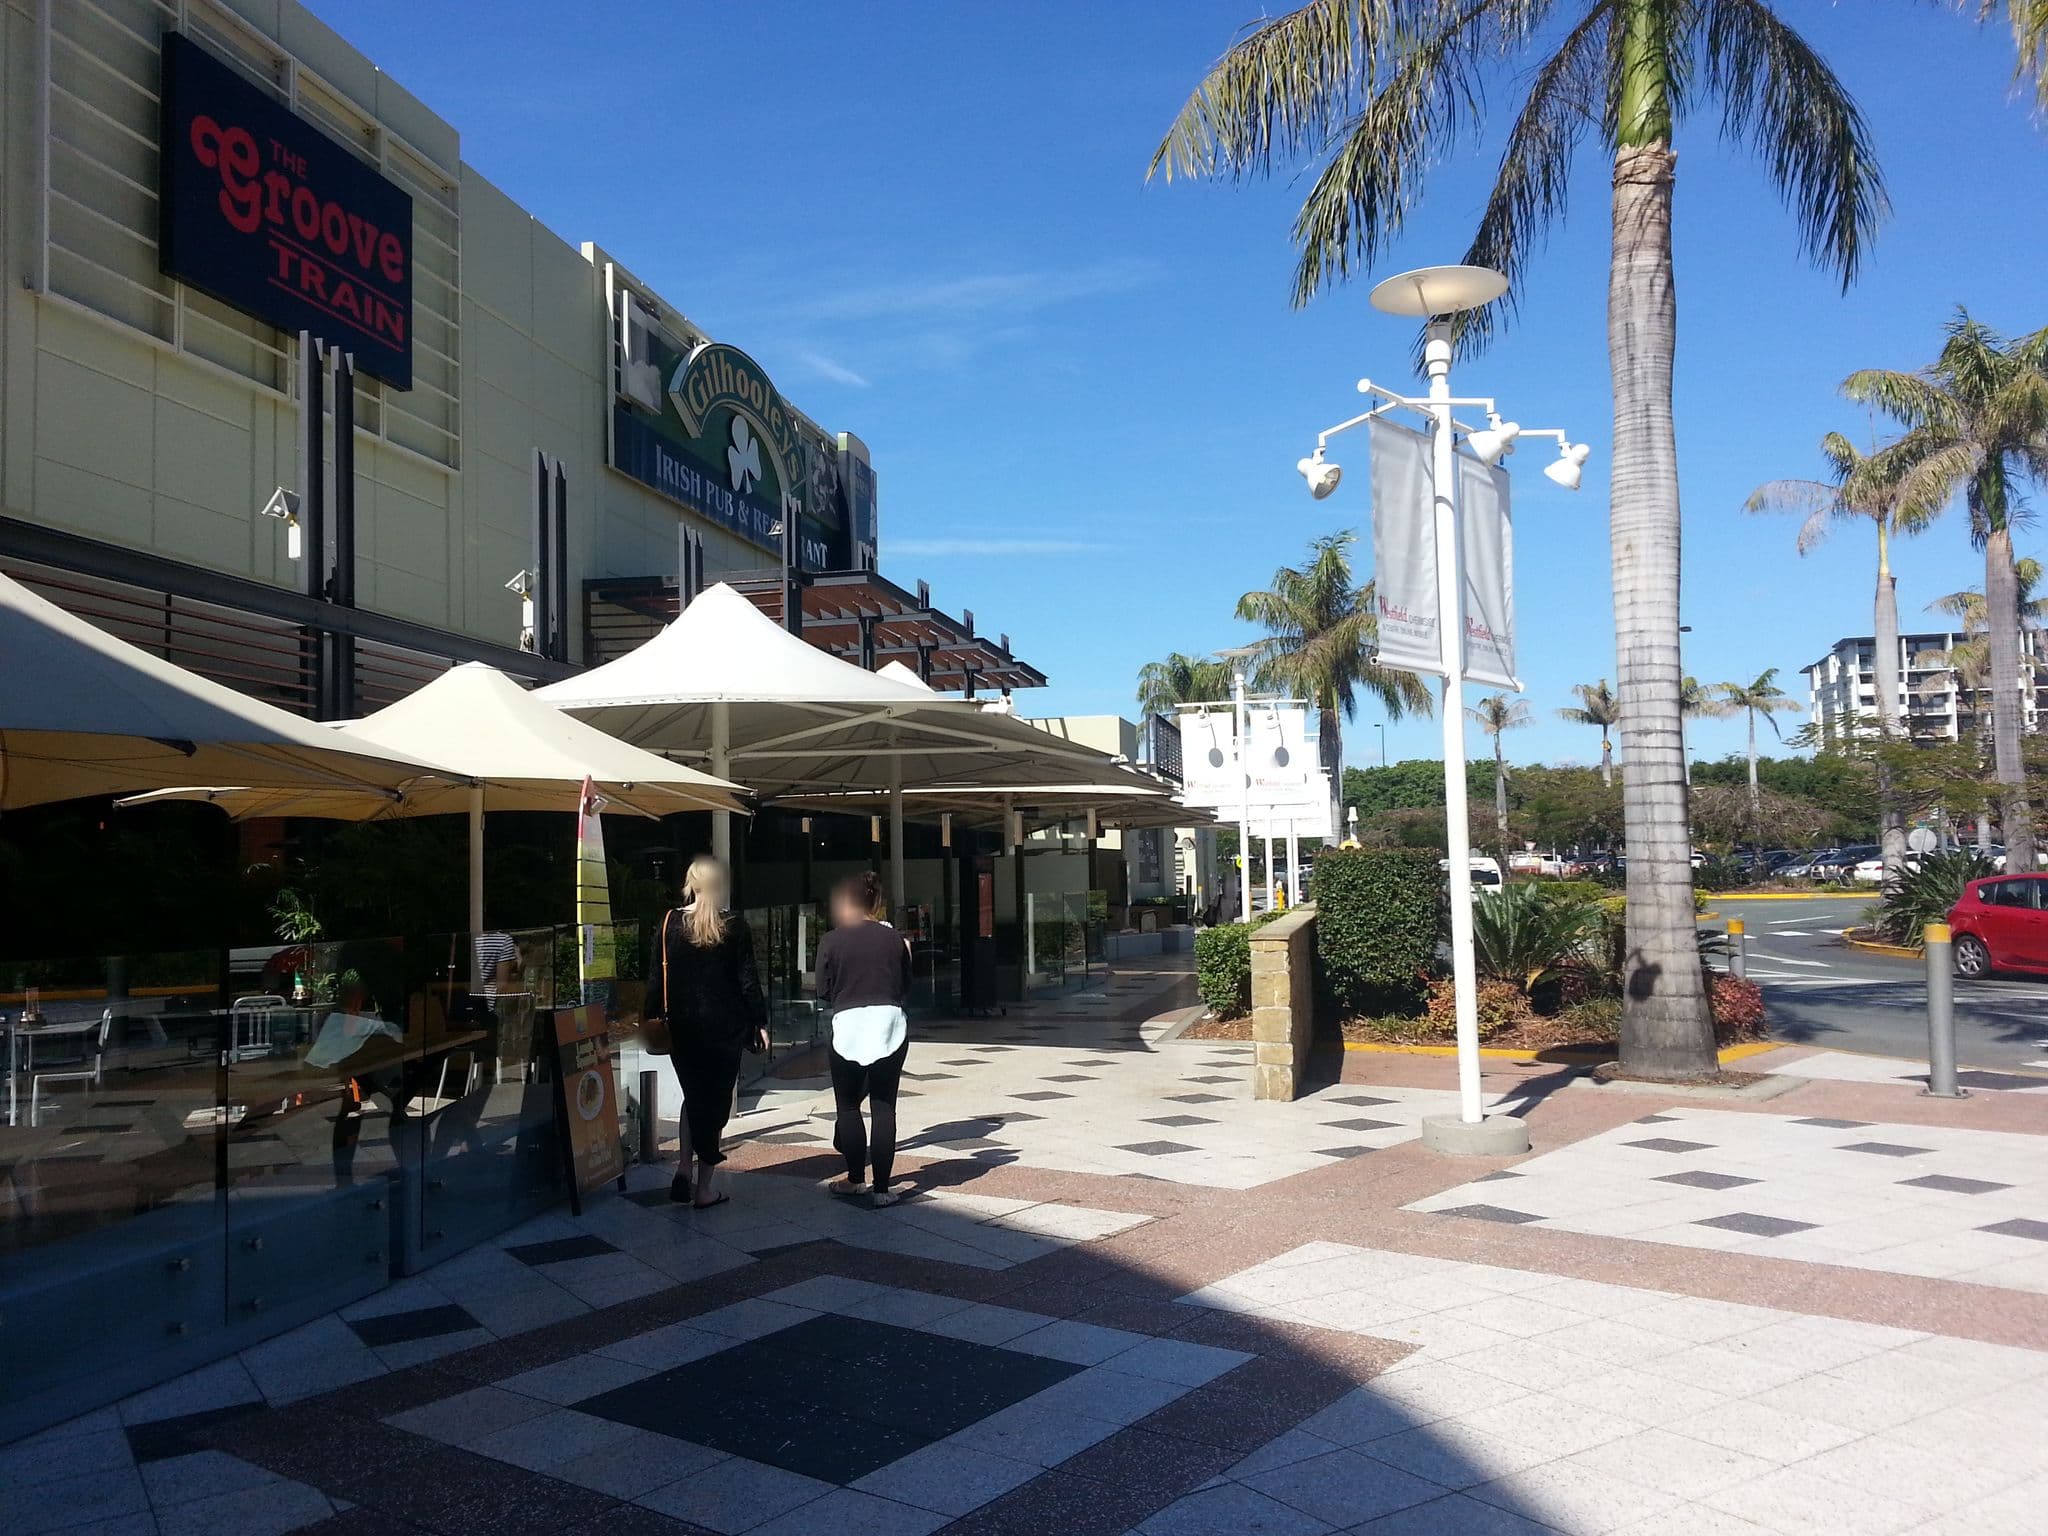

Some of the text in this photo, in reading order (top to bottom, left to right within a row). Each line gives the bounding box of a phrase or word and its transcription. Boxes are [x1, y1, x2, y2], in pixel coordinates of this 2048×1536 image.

[269, 138, 308, 180] THE
[269, 239, 404, 342] TRAIN
[655, 444, 828, 569] IRISH PUB & REANT
